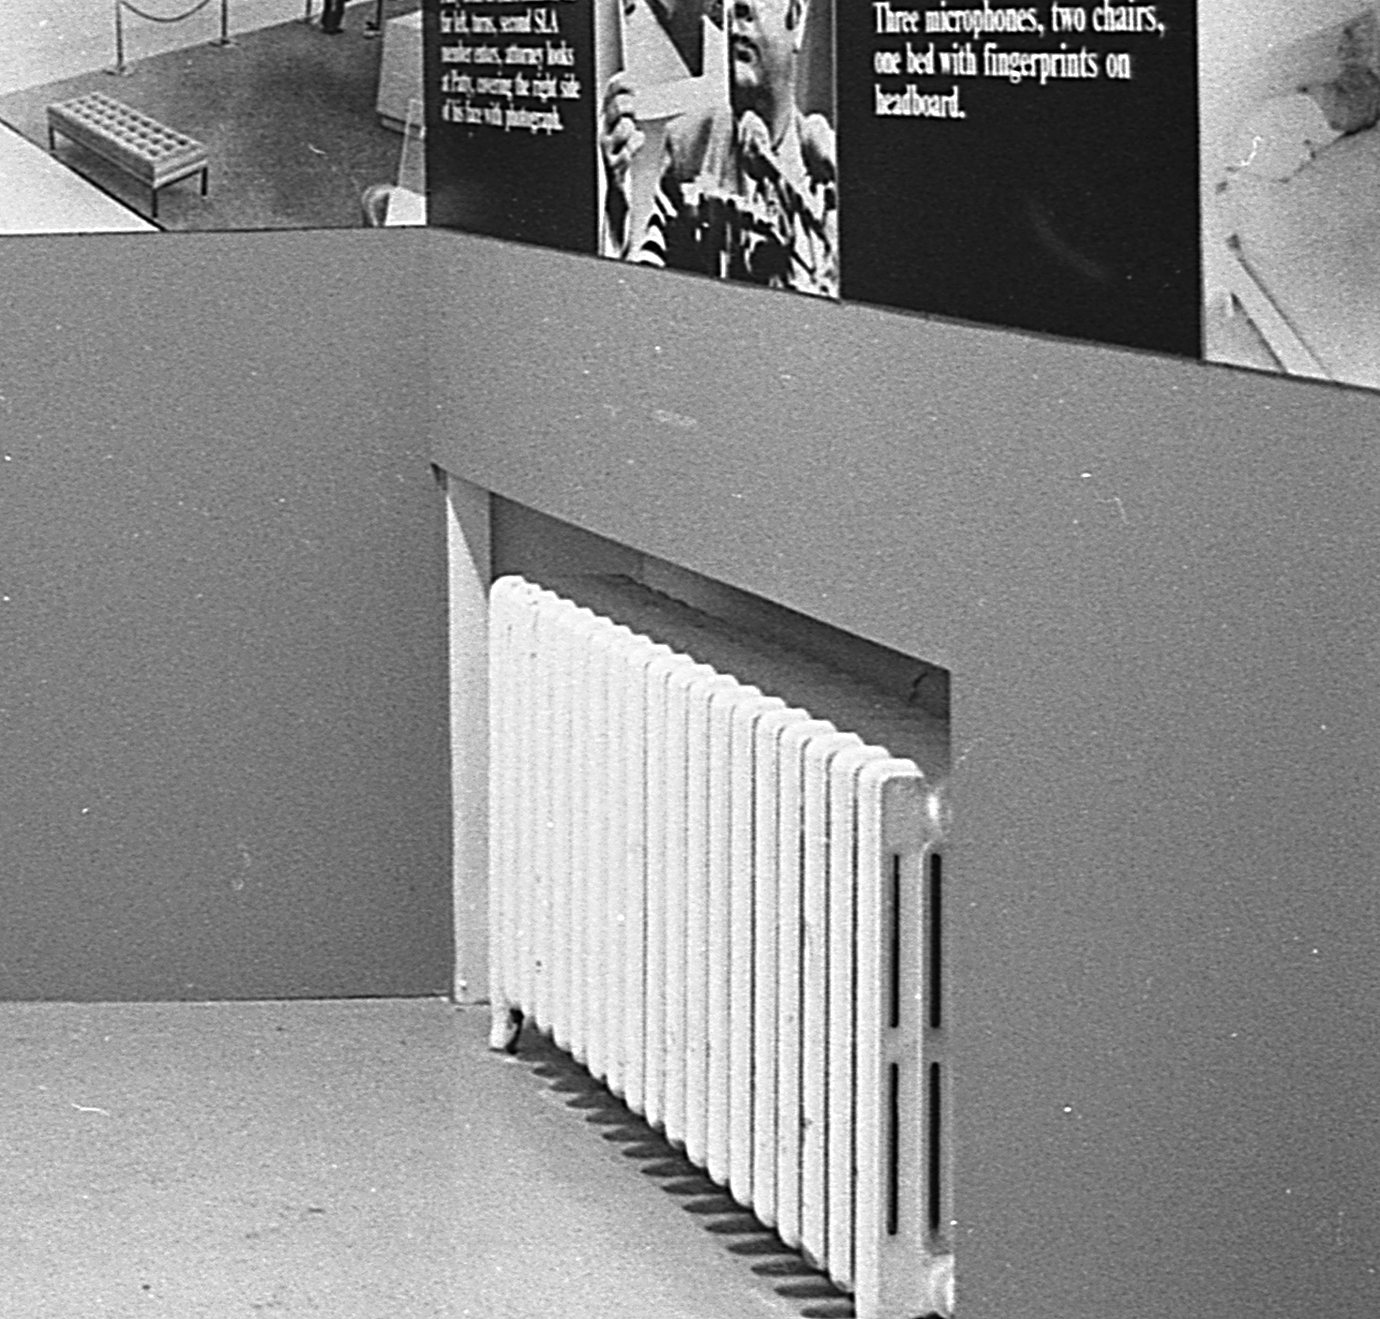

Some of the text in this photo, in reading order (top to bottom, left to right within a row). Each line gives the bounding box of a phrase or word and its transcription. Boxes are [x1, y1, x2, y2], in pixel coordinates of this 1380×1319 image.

[535, 8, 559, 33] SLA
[873, 2, 919, 33] Three
[925, 0, 1045, 39] microphones,
[1051, 2, 1086, 31] two
[874, 42, 1131, 85] one bed with fingerprints on
